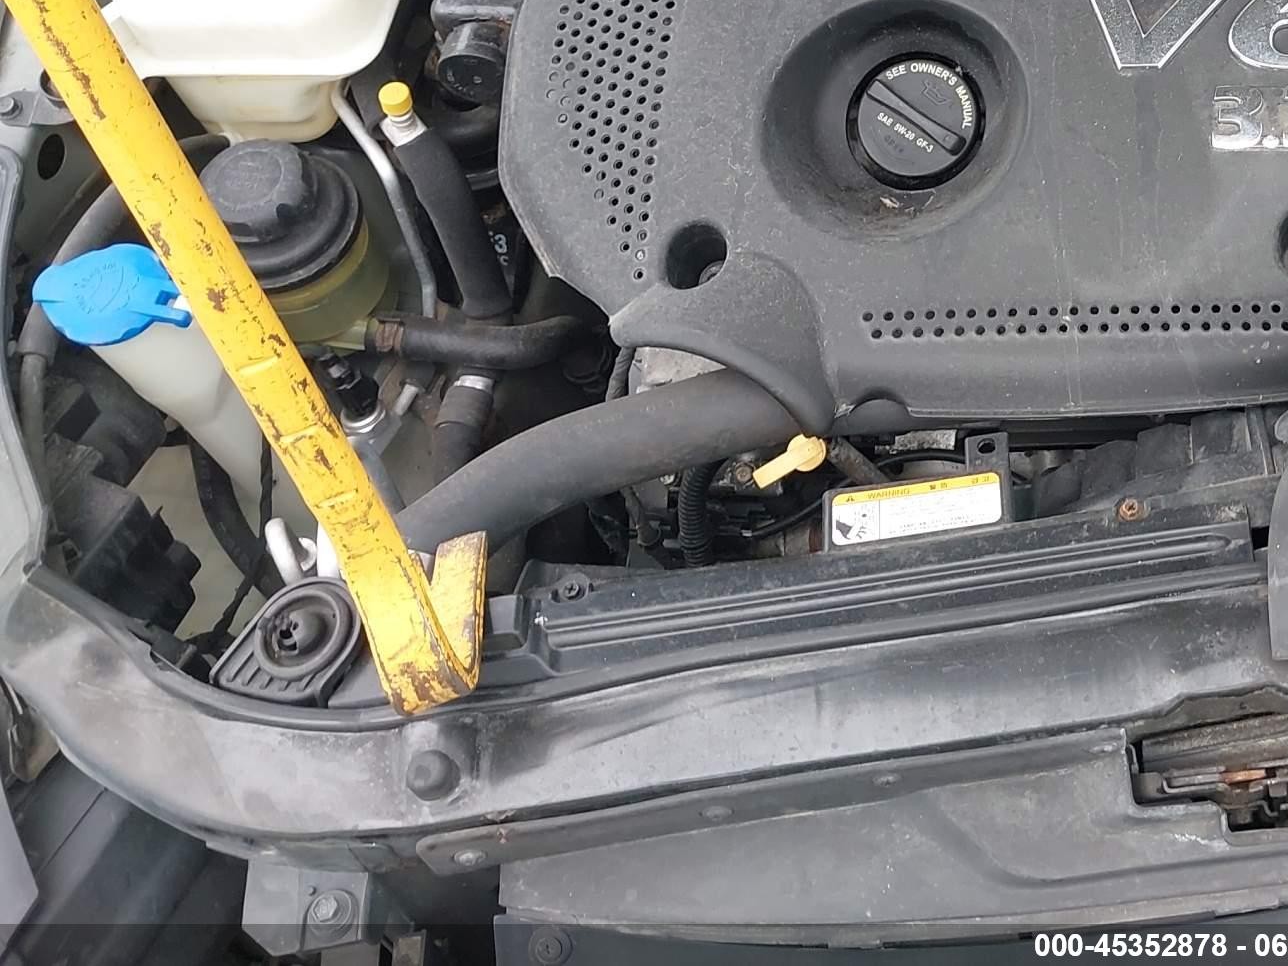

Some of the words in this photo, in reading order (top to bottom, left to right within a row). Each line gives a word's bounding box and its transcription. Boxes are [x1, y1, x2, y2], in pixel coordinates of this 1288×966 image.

[886, 64, 907, 80] SEE
[910, 62, 957, 86] OWNER'S
[955, 85, 973, 129] MANUAL
[877, 112, 894, 127] SAE
[893, 123, 916, 140] 5W-20
[867, 488, 911, 500] WARNING
